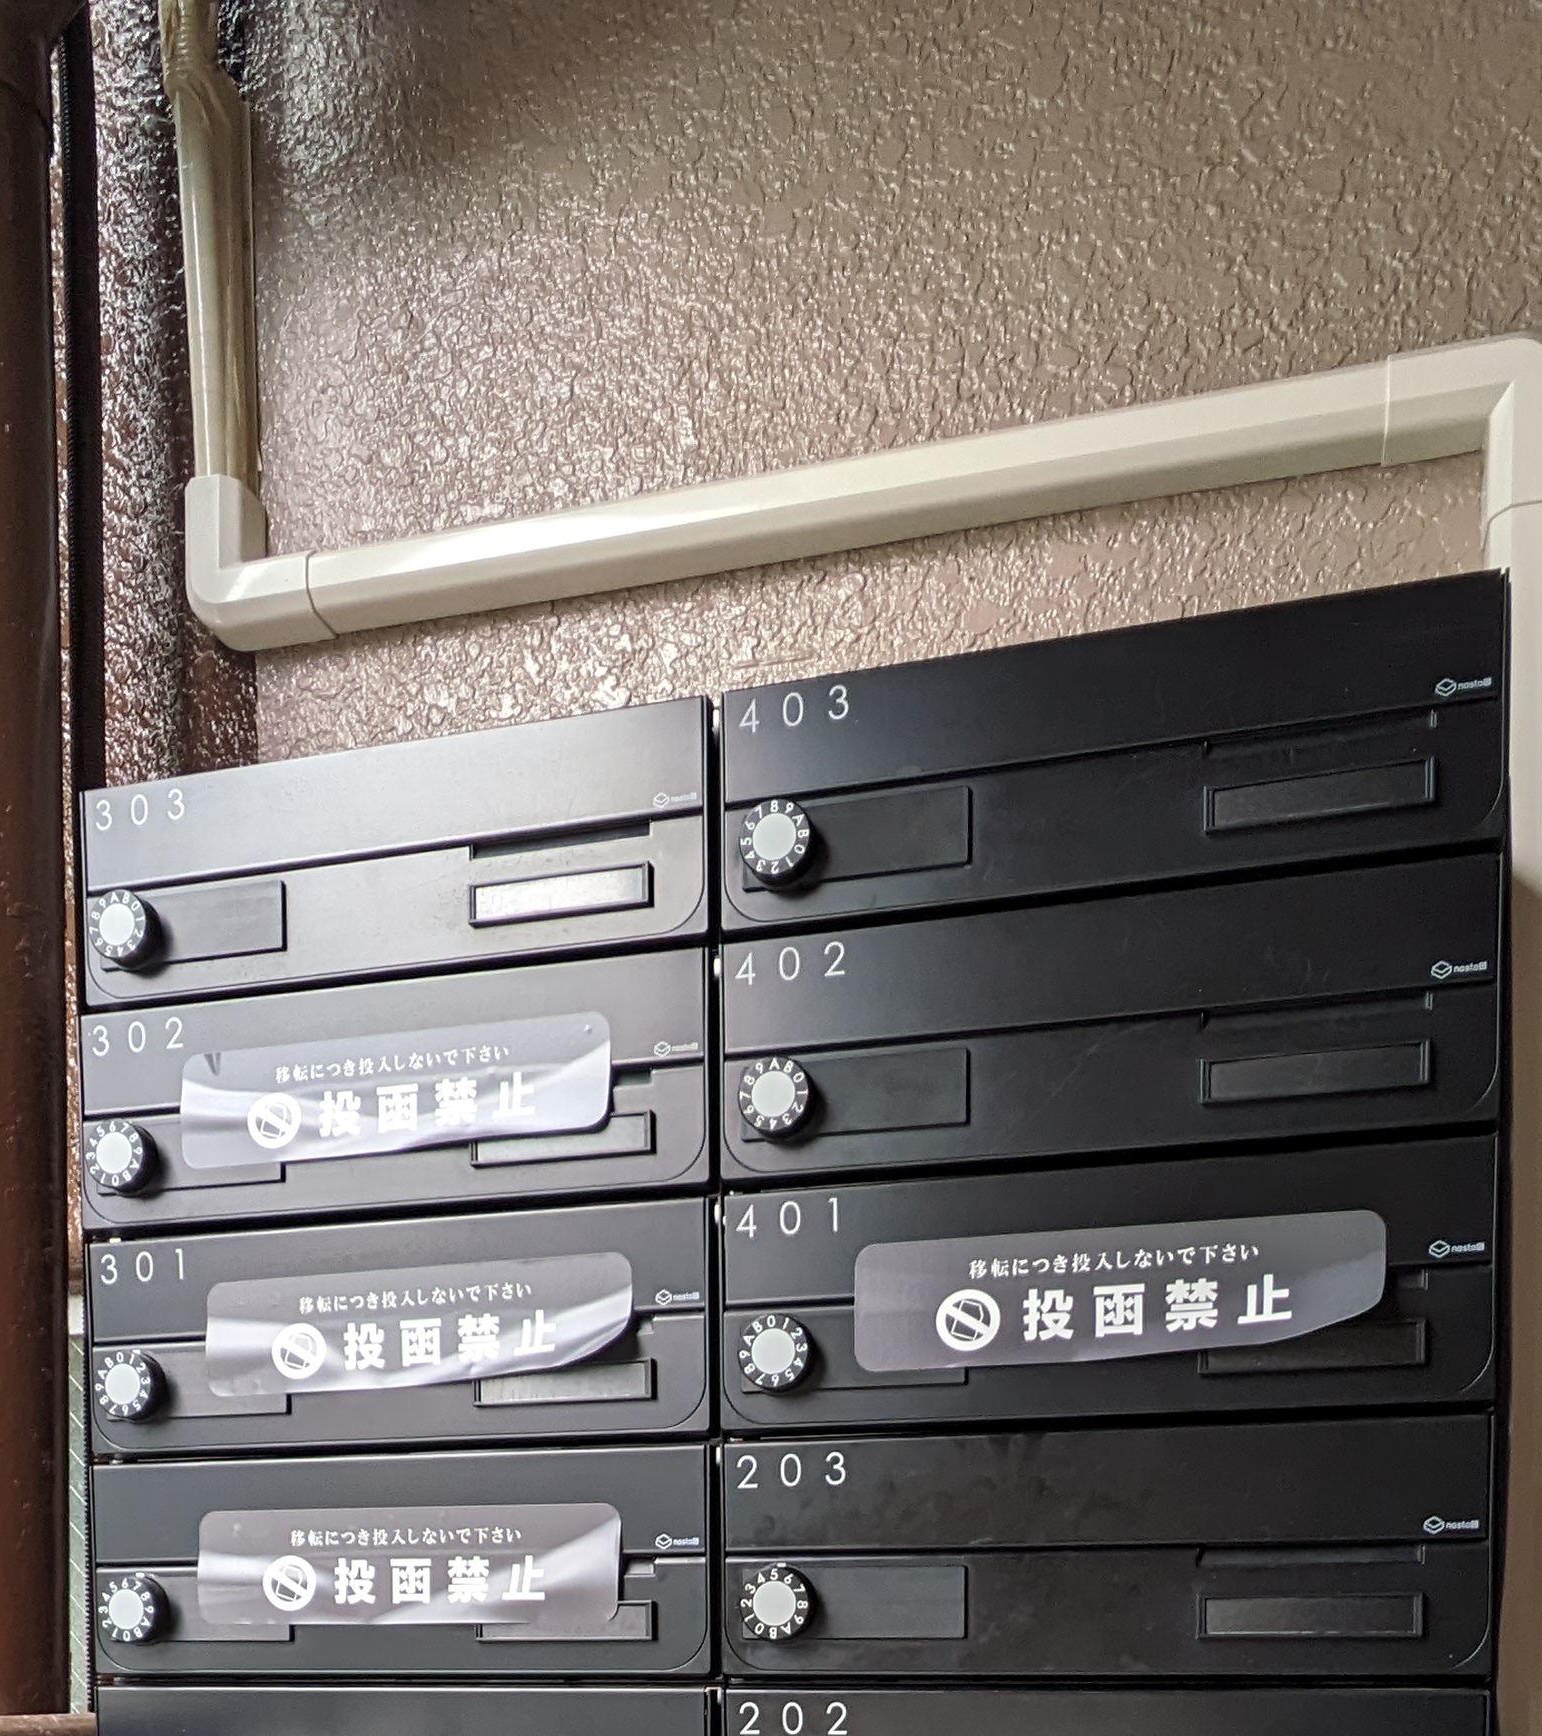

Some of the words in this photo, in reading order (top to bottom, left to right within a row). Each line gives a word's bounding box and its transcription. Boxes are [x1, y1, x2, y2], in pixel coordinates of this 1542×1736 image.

[739, 684, 850, 733] 403
[95, 788, 185, 831] 303
[735, 940, 845, 985] 402
[92, 1017, 184, 1057] 302
[275, 1045, 509, 1084] 移転につき投入しないで下さい
[319, 1072, 535, 1138] 投函禁止
[736, 1197, 840, 1238] 401
[101, 1248, 185, 1285] 301
[969, 1243, 1259, 1280] 移転につき投入しないで下さい
[298, 1282, 532, 1314] 移転につき投入しないで下さい
[1023, 1274, 1292, 1342] 投函禁止
[343, 1310, 556, 1370] 投函禁止
[736, 1452, 847, 1488] 203
[290, 1527, 522, 1547] 移転につき投入しないで下さい
[334, 1555, 545, 1604] 投函禁止
[738, 1701, 848, 1736] 202
